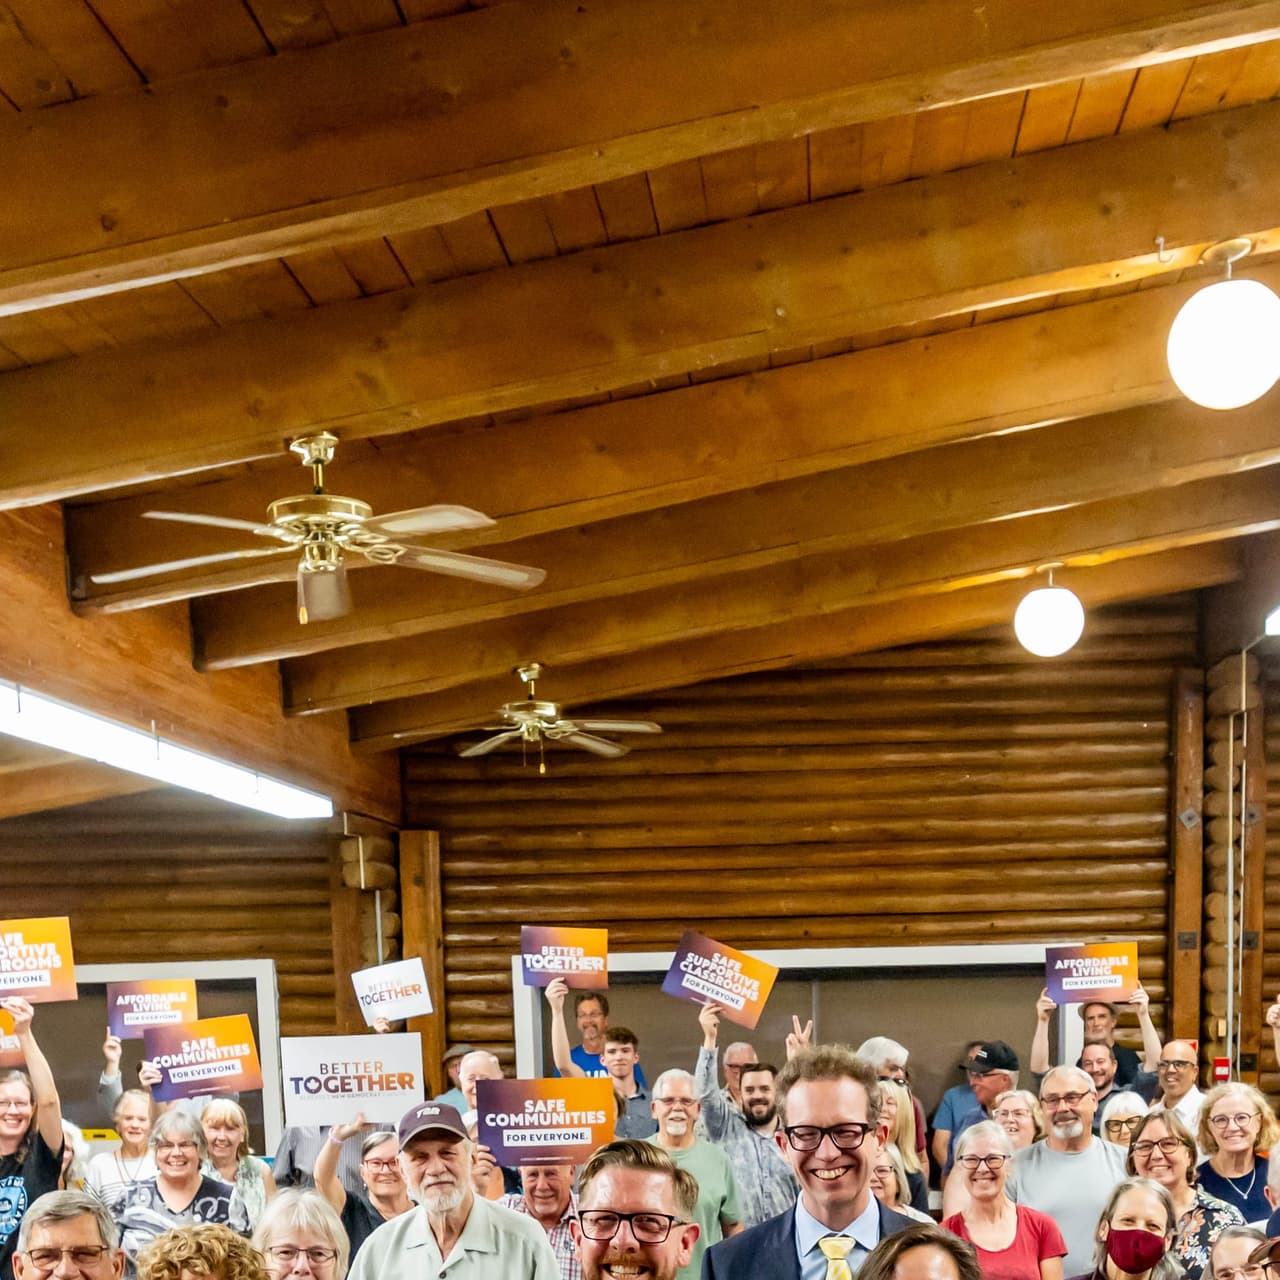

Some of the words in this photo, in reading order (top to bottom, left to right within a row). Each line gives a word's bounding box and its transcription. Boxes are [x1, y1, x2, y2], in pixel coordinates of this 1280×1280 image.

[541, 945, 585, 957] BETTER
[523, 953, 605, 971] TOGETHER
[711, 952, 743, 973] SAFE
[1054, 955, 1129, 969] AFFORDABLE
[686, 952, 760, 991] SUPPORTIVE
[1072, 965, 1112, 977] LIVING
[679, 960, 760, 1002] CLASSROOMS
[685, 977, 701, 988] FOR
[116, 991, 188, 1006] AFFORDABLE
[359, 983, 423, 1007] TOGETHER
[132, 1002, 171, 1012] LIVING
[181, 1036, 217, 1054] SAFE
[152, 1043, 251, 1069] COMMUNITIES
[171, 1070, 190, 1079] FOR
[319, 1060, 384, 1075] BETTER
[289, 1072, 415, 1095] TOGETHER
[524, 1099, 566, 1112] SAFE
[485, 1111, 606, 1127] COMMUNITIES
[506, 1134, 527, 1142] FOR
[529, 1131, 589, 1142] EVERYONE.
